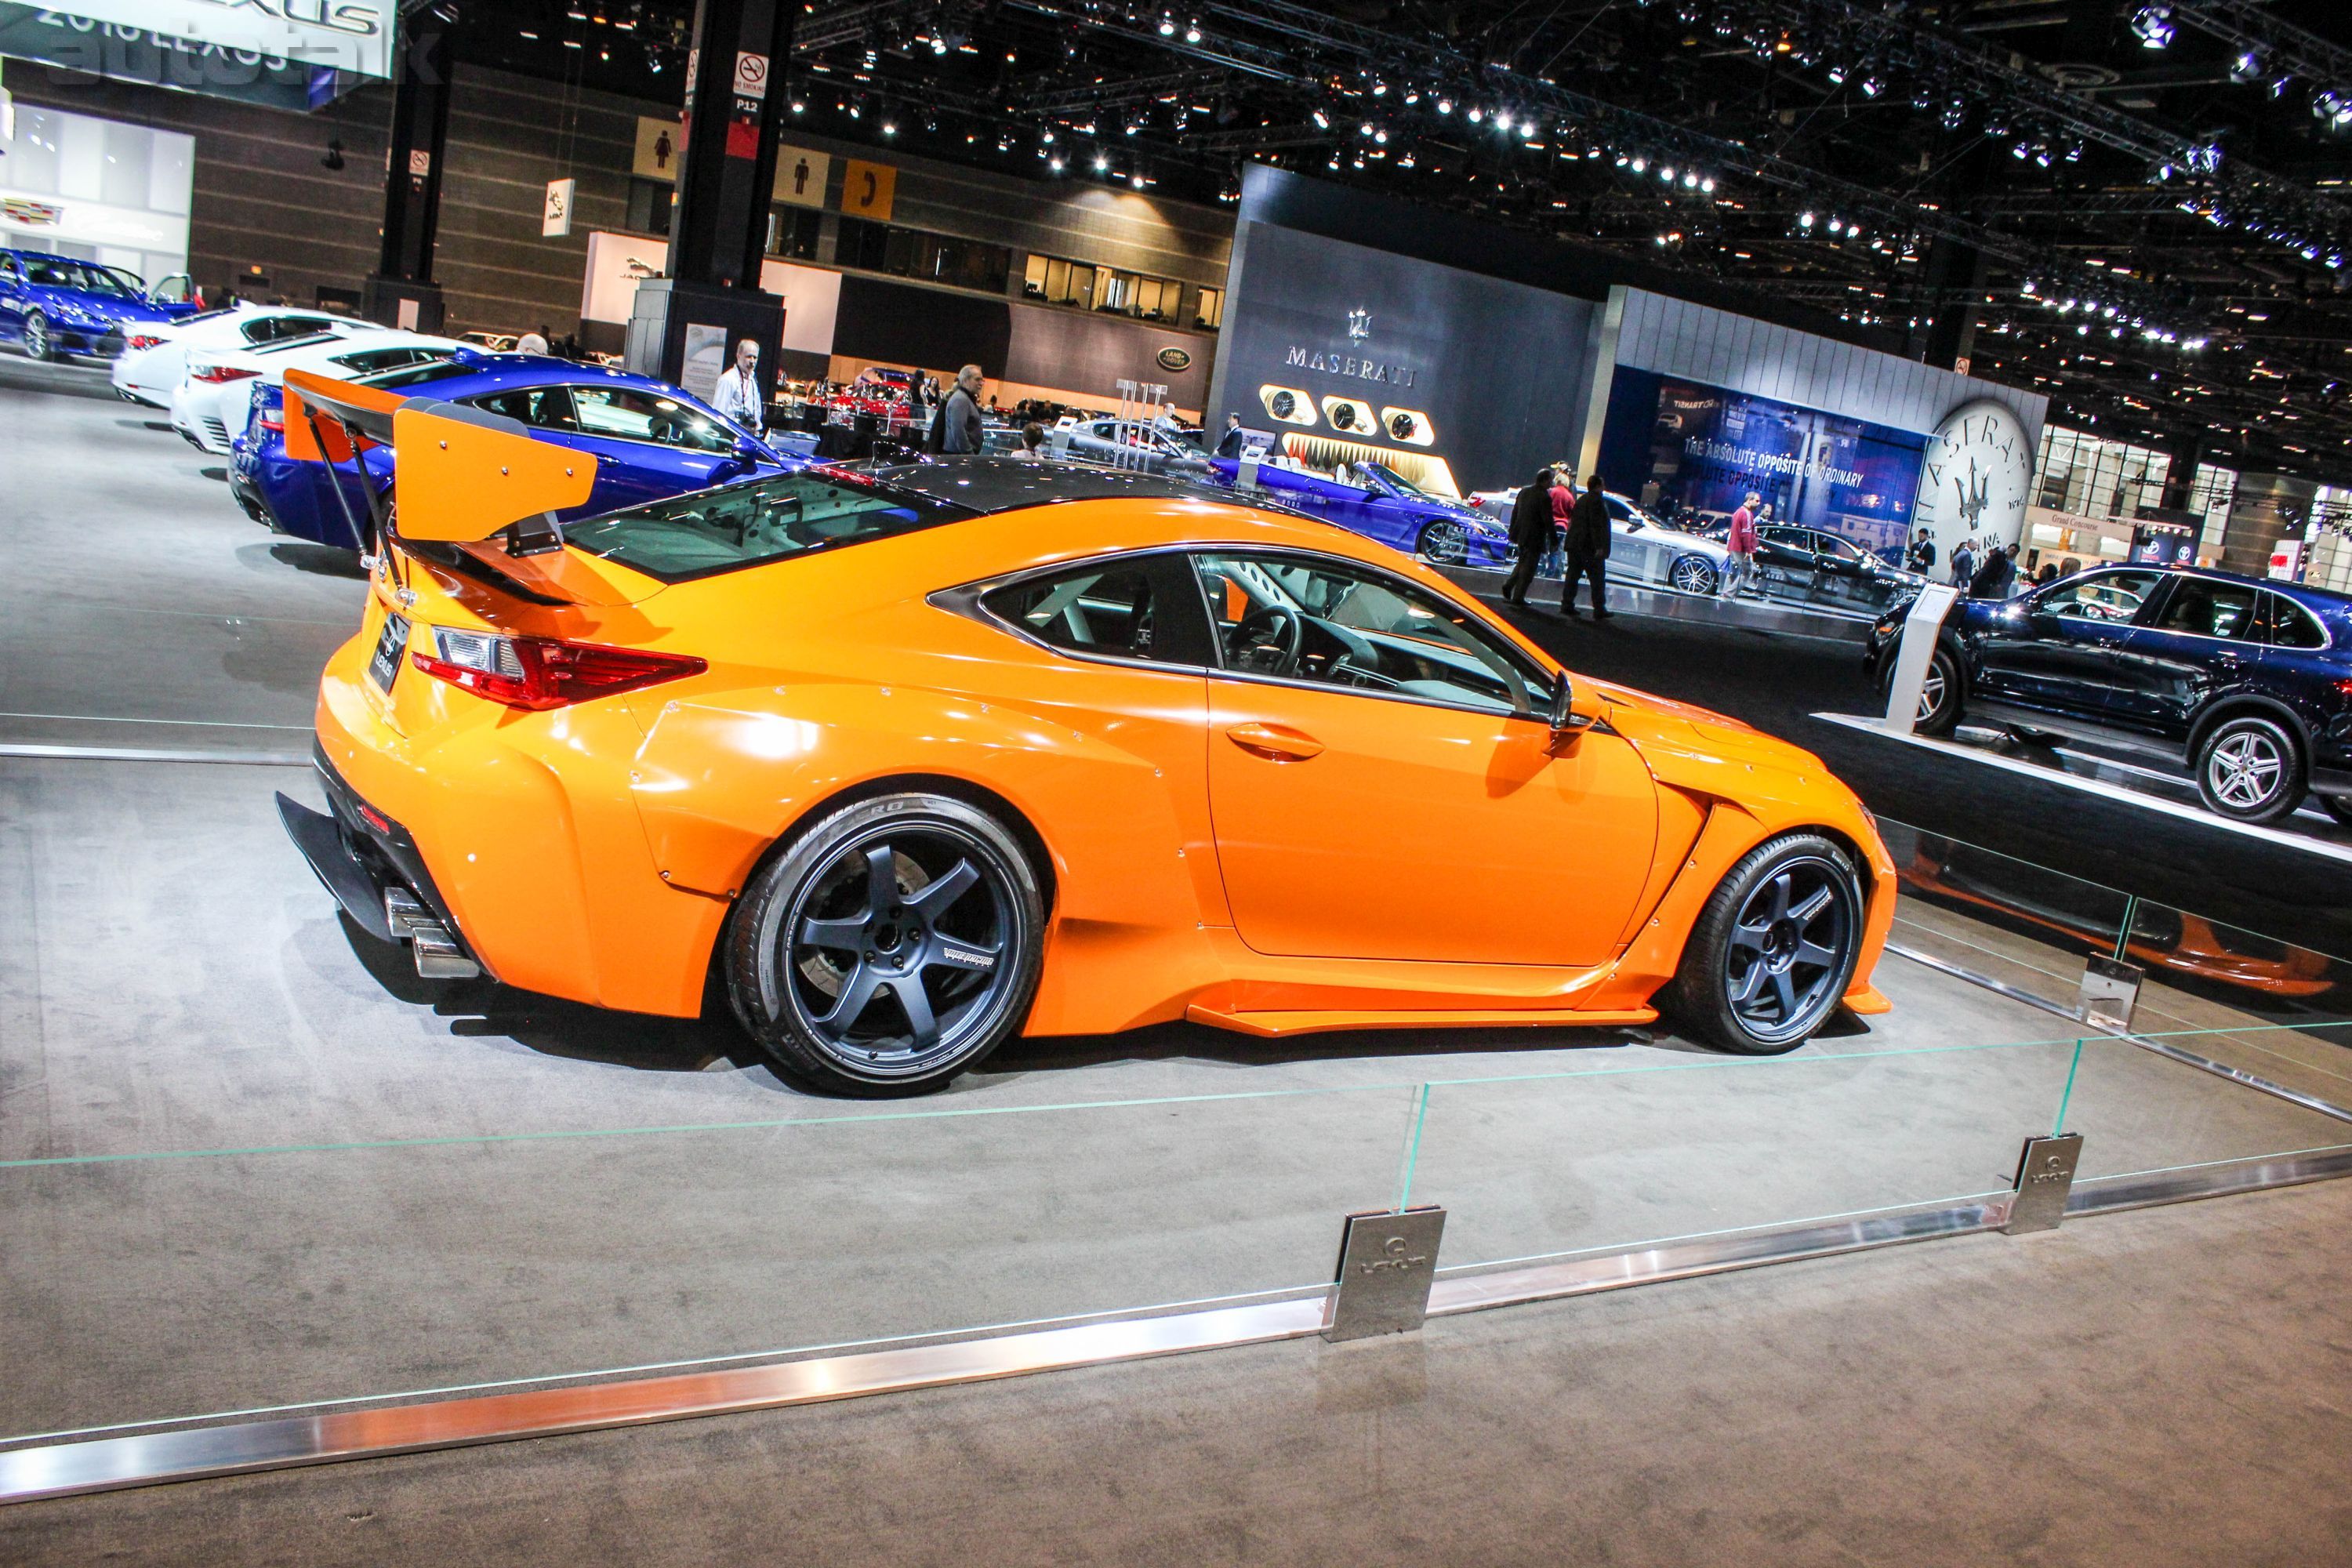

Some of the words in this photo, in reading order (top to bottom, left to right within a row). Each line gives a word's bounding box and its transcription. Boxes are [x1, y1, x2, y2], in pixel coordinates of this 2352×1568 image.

[737, 99, 758, 112] P12
[1286, 346, 1417, 388] MASERATI
[1686, 439, 1704, 456] THE
[1705, 443, 1756, 466] ABSOLUTE
[1758, 453, 1803, 476] OPPOSITE
[1819, 467, 1864, 488] ORDINARY
[2052, 514, 2069, 524] Grand
[2070, 518, 2099, 531] Concourse
[376, 651, 393, 678] LEXUS
